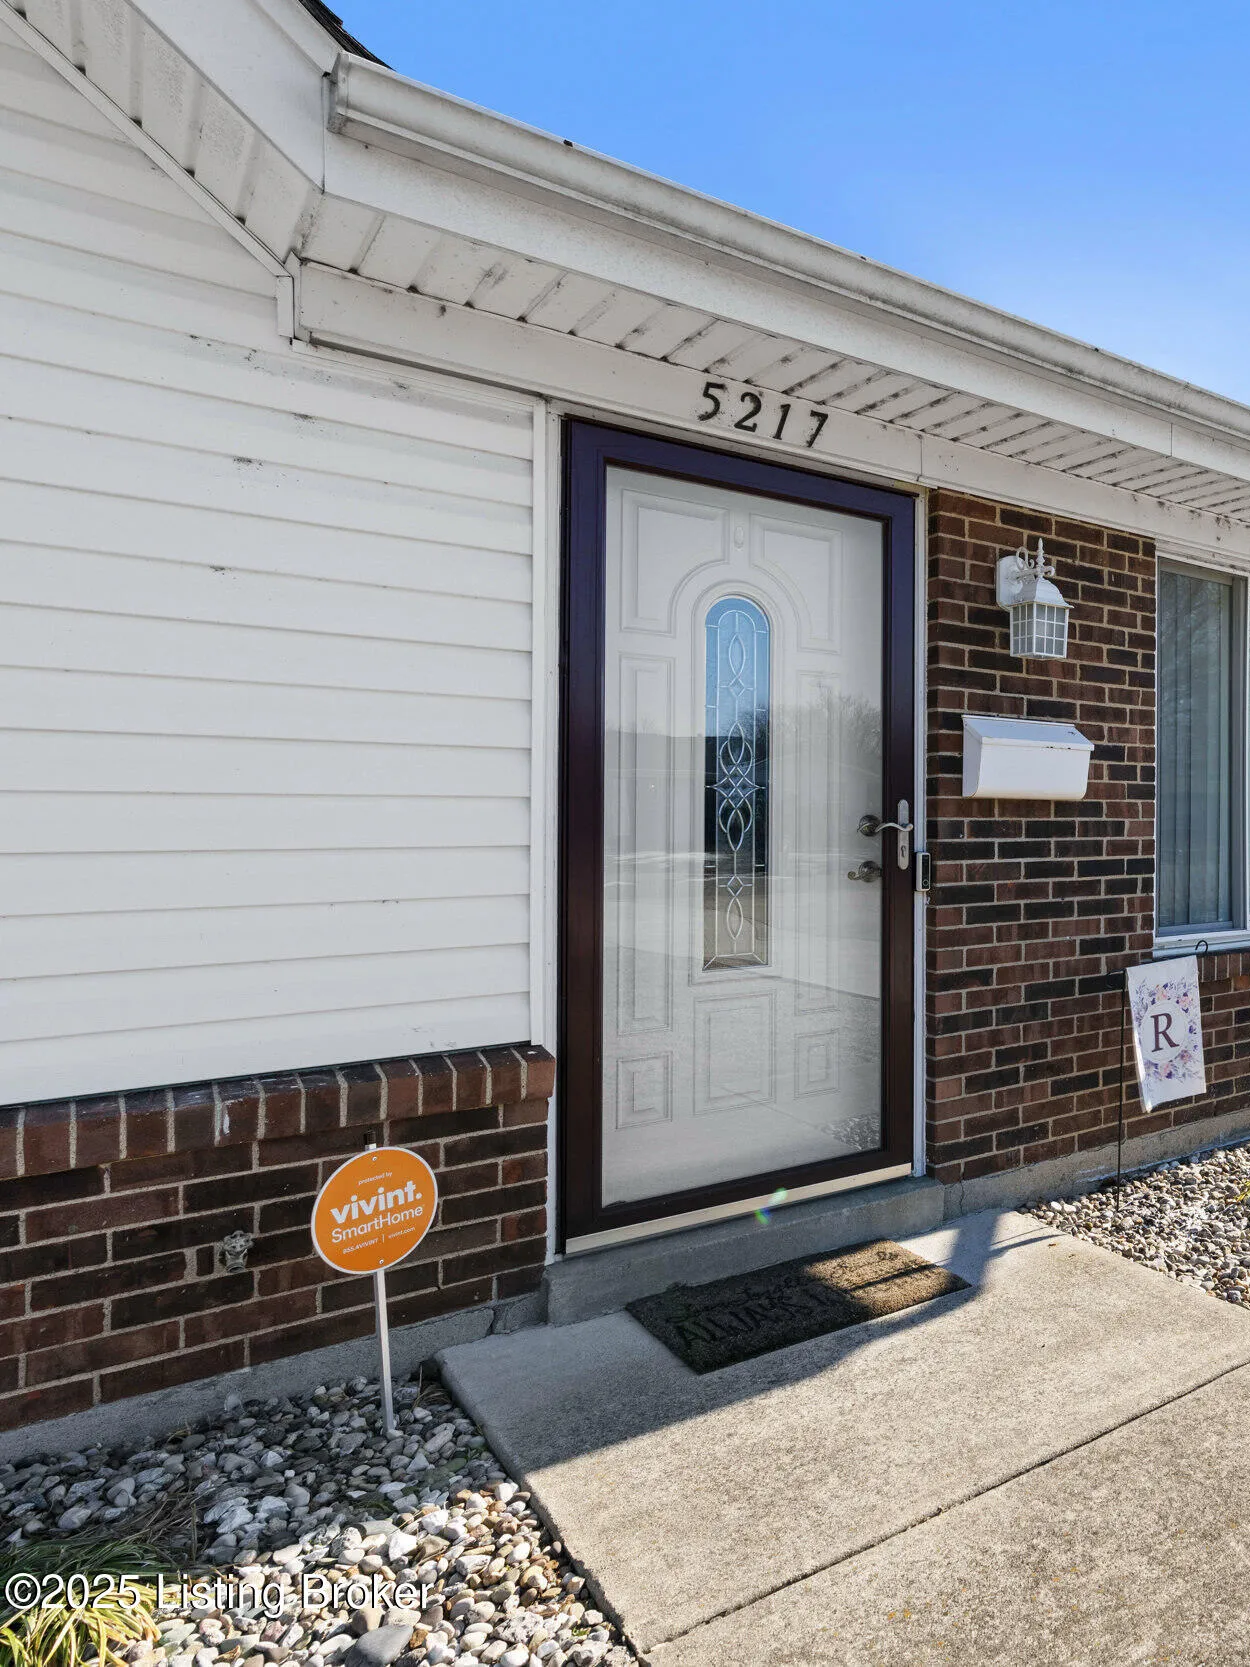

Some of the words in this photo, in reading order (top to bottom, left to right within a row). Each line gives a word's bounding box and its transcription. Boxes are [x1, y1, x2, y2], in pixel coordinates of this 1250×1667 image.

[698, 381, 829, 448] 5217
[1150, 1012, 1180, 1053] R
[358, 1173, 385, 1185] protected
[385, 1171, 393, 1179] by
[331, 1205, 424, 1244] SmartHome
